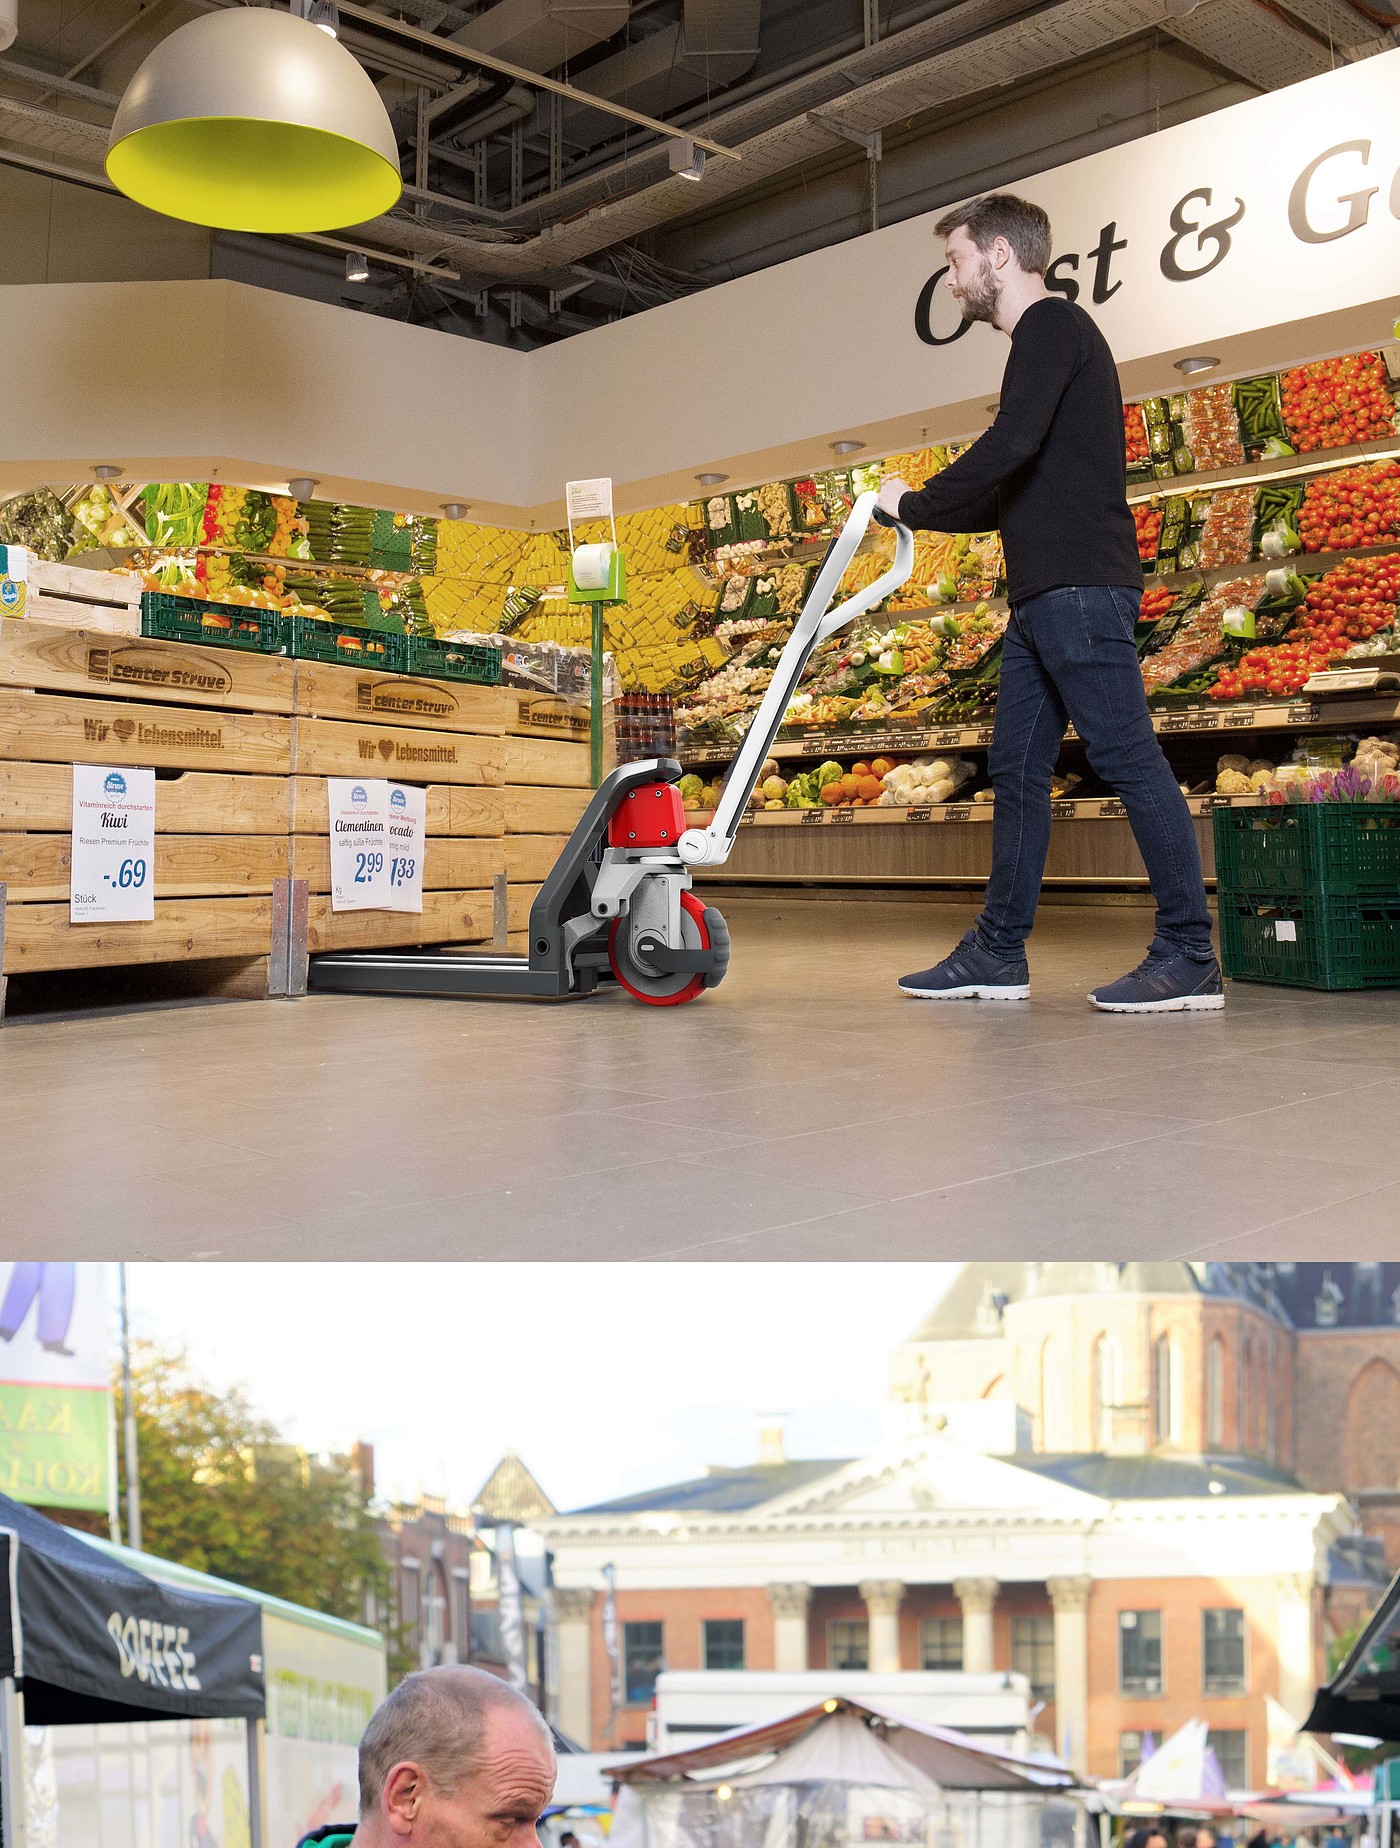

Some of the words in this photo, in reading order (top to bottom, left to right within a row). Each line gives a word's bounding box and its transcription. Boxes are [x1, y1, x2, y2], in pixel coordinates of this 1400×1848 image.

[914, 220, 1128, 346] Ost
[1159, 187, 1245, 282] &
[1287, 138, 1400, 244] G
[112, 664, 170, 682] center
[171, 670, 226, 689] Struve
[374, 694, 415, 710] center
[415, 698, 455, 714] Struve
[532, 711, 563, 724] center
[84, 719, 110, 741] Wir
[138, 723, 225, 749] Lebensmittel.
[358, 740, 377, 759] Wir
[396, 742, 458, 763] Lebensmittel.
[79, 800, 117, 809] Vitaminreich
[117, 803, 153, 812] durchstarten
[100, 812, 128, 829] Kiwi
[335, 819, 384, 833] Clementinen
[389, 825, 415, 838] ocado
[79, 837, 100, 845] Riesen
[101, 837, 127, 846] Premium
[128, 838, 149, 847] Früchte
[339, 838, 352, 848] saftig
[365, 837, 383, 846] Früchte
[354, 852, 384, 883] 2.99
[74, 894, 97, 904] Stück
[107, 1611, 202, 1691] COFFEE
